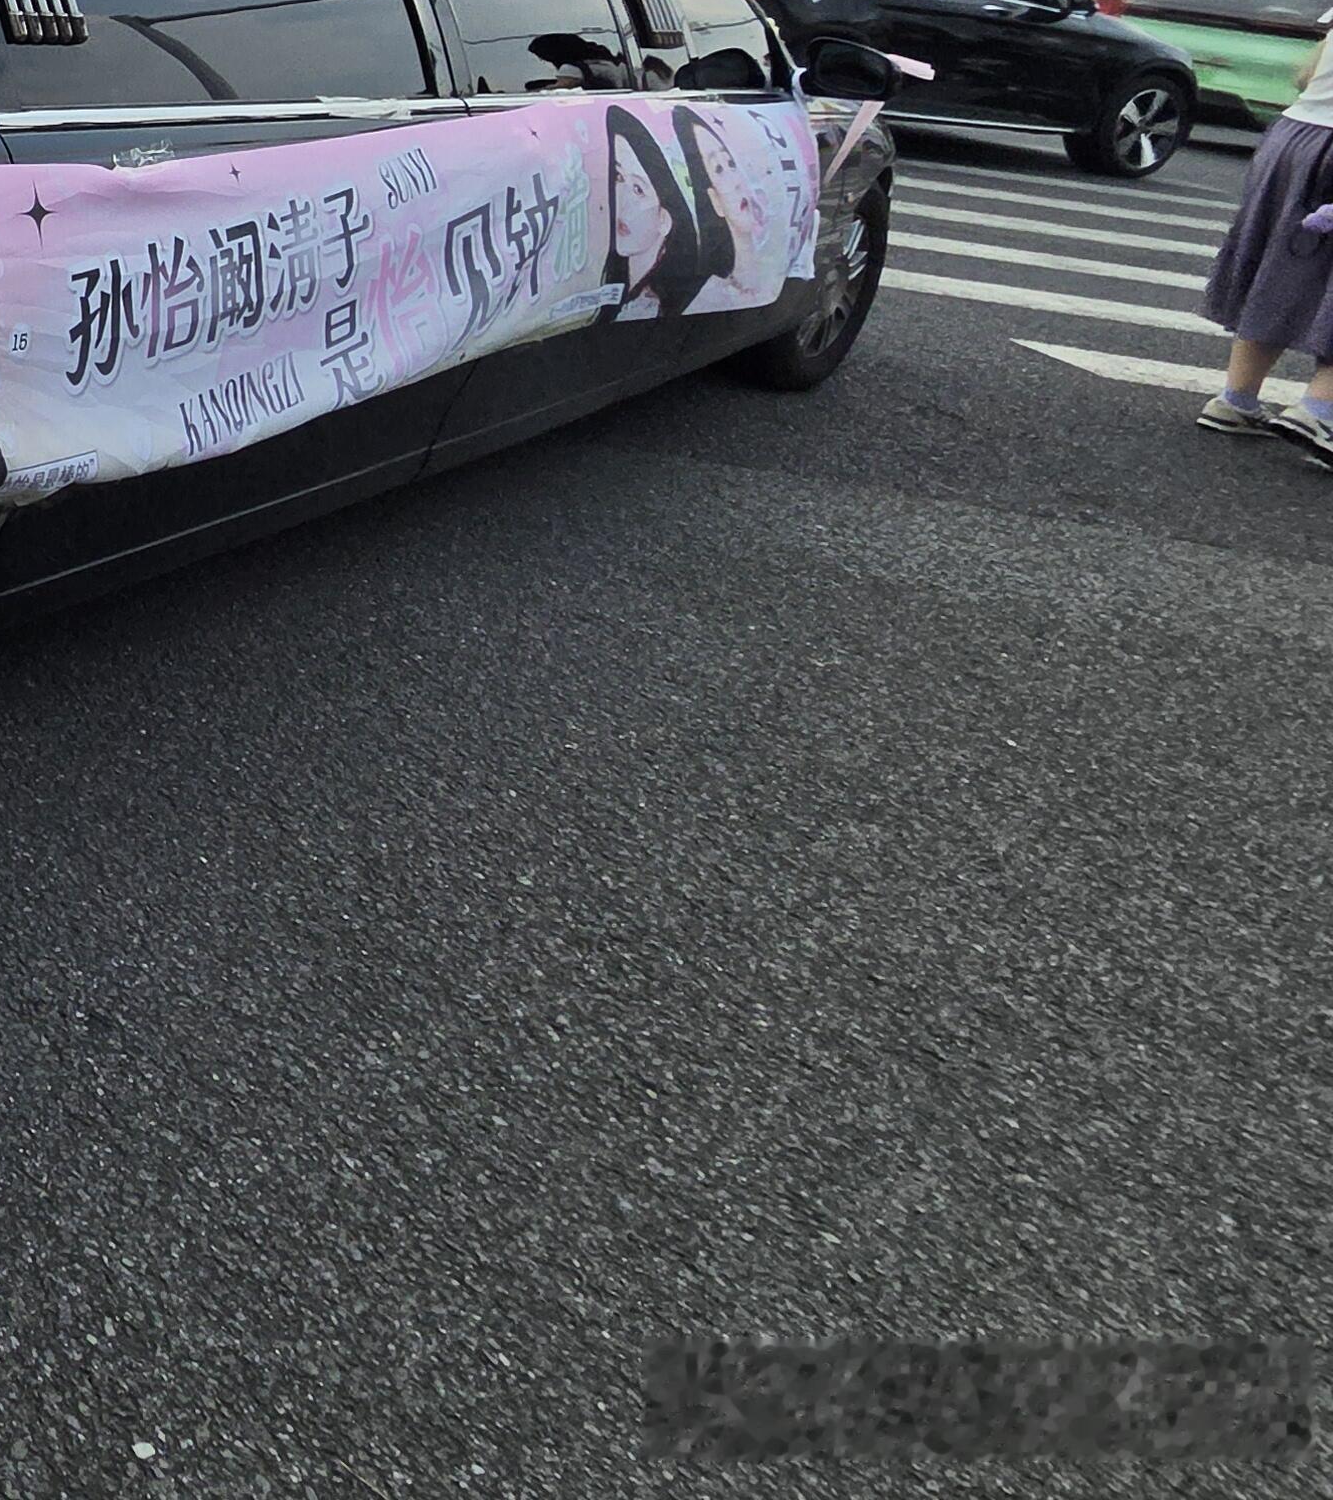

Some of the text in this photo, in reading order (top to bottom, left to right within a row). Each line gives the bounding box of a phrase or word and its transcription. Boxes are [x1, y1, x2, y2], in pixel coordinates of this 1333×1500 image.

[66, 187, 371, 387] 孙怡阚清子
[12, 332, 29, 353] 15
[179, 350, 306, 457] KANQINGZI
